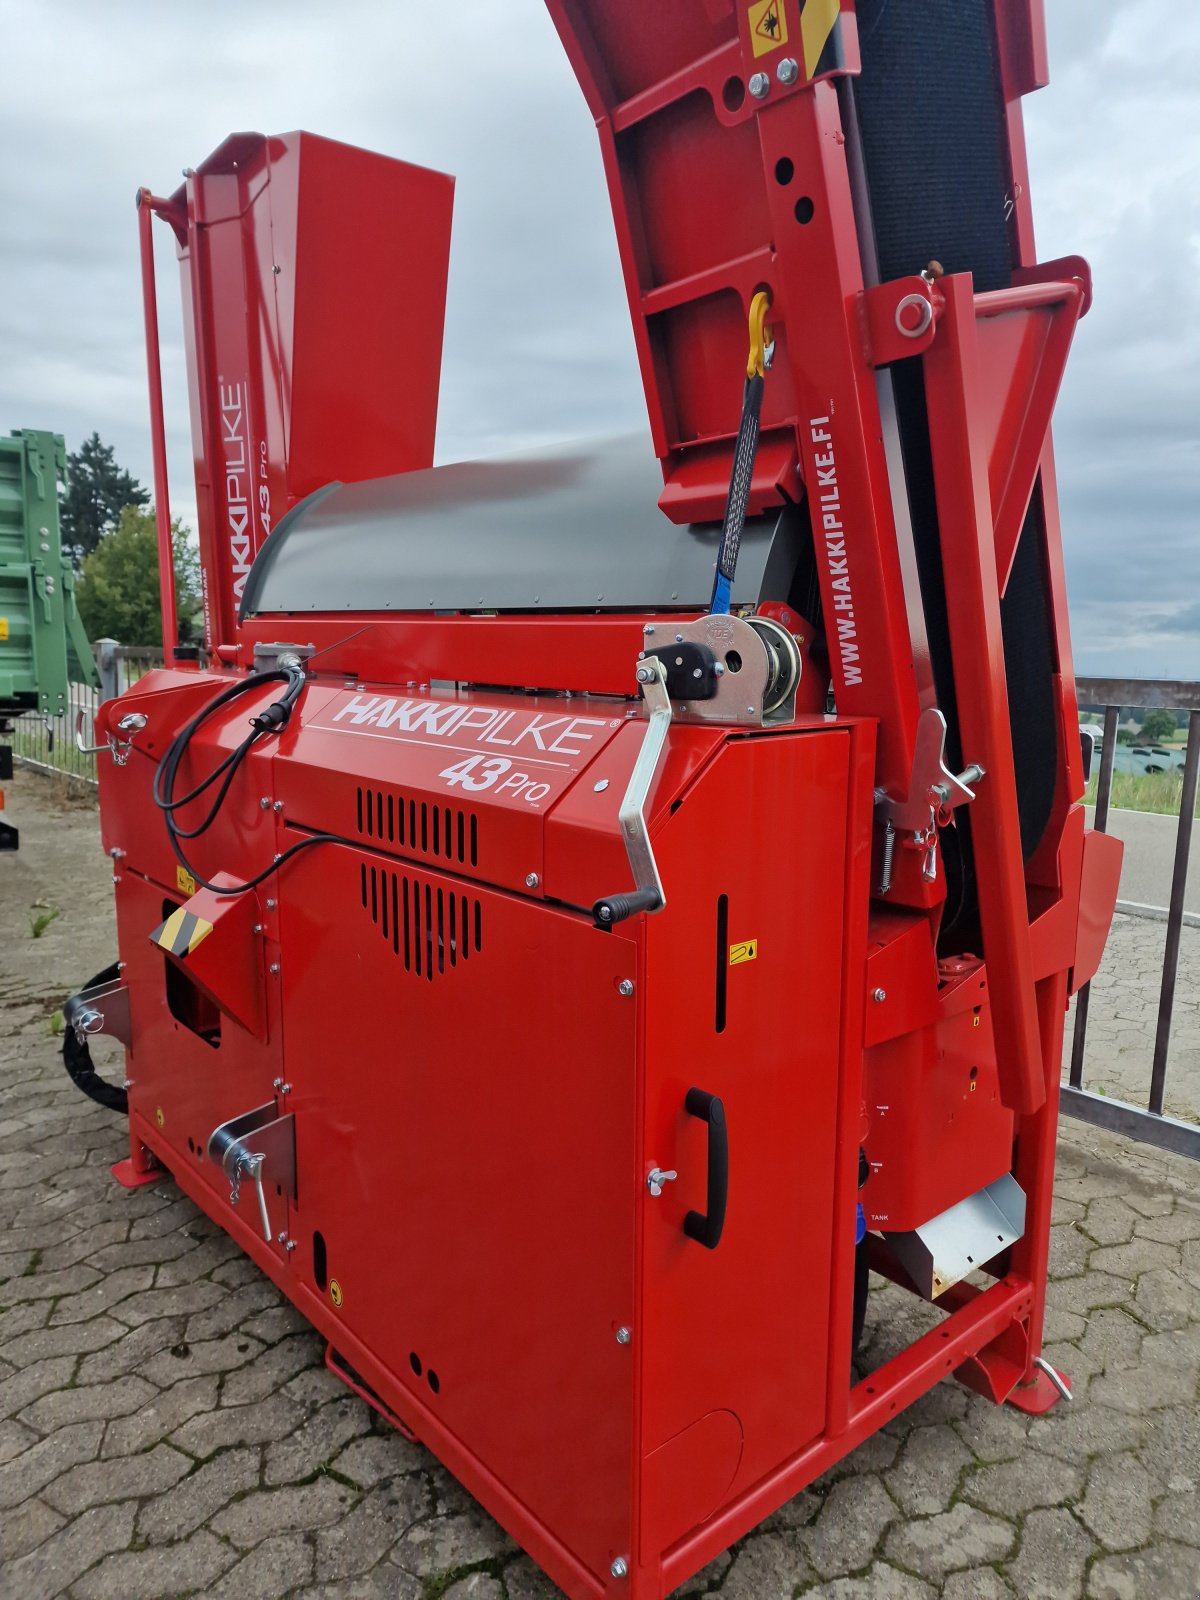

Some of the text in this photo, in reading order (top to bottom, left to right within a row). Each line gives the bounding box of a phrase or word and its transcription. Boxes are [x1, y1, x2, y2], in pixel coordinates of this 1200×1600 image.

[259, 441, 271, 535] 43 Pro
[810, 416, 862, 686] WWW.HAKKIPILKE.FI
[438, 754, 551, 801] 43 Pro
